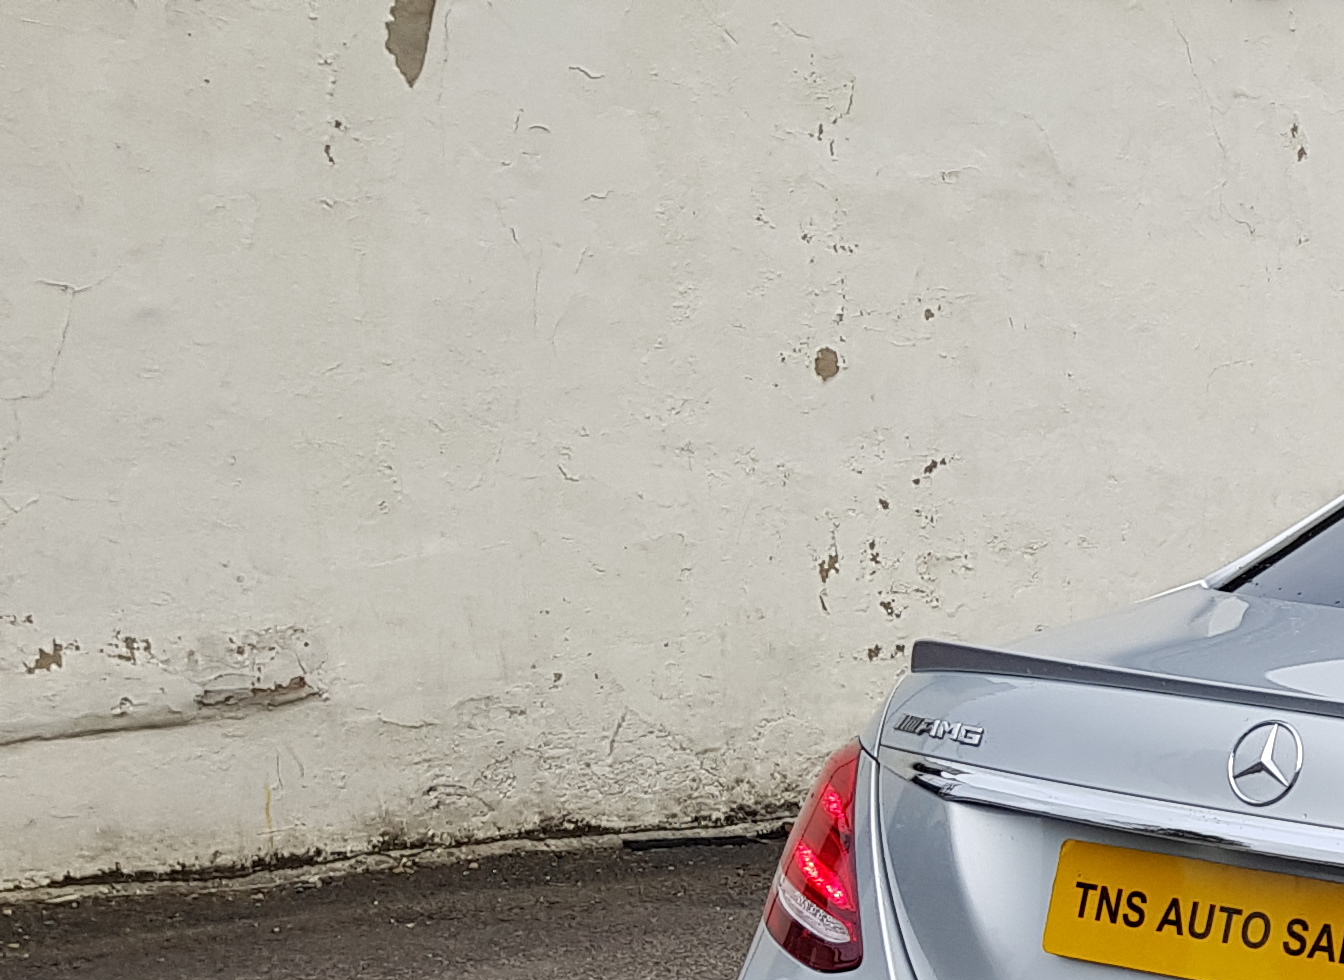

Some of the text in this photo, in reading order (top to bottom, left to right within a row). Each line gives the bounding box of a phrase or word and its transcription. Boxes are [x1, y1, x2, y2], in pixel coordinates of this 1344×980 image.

[914, 718, 985, 747] AMG
[1075, 881, 1148, 928] TNS
[1156, 897, 1272, 949] AUTO
